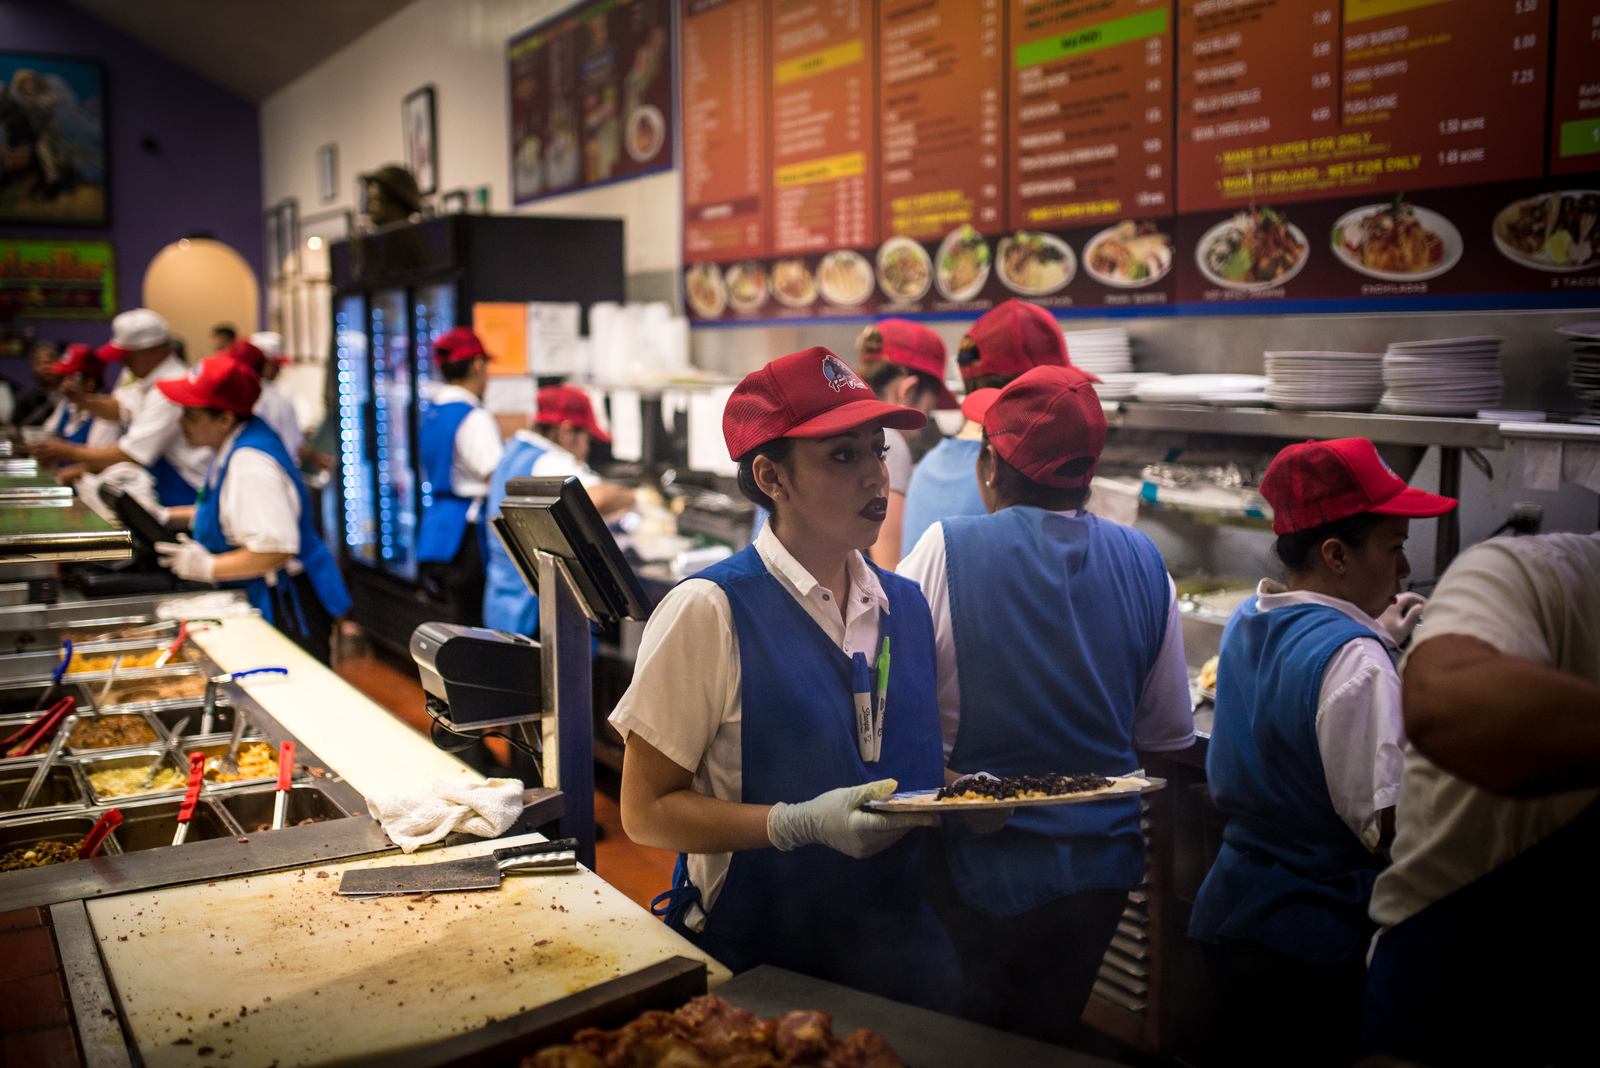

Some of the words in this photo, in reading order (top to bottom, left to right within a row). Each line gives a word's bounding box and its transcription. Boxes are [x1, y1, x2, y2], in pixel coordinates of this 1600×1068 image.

[1461, 117, 1486, 131] MORE
[1271, 139, 1308, 158] SUPER
[1311, 136, 1335, 153] FOR
[1337, 131, 1374, 149] ONLY
[1460, 147, 1486, 162] MORE
[1327, 162, 1353, 179] WET
[1356, 159, 1383, 177] FOR
[1386, 154, 1422, 172] ONLY
